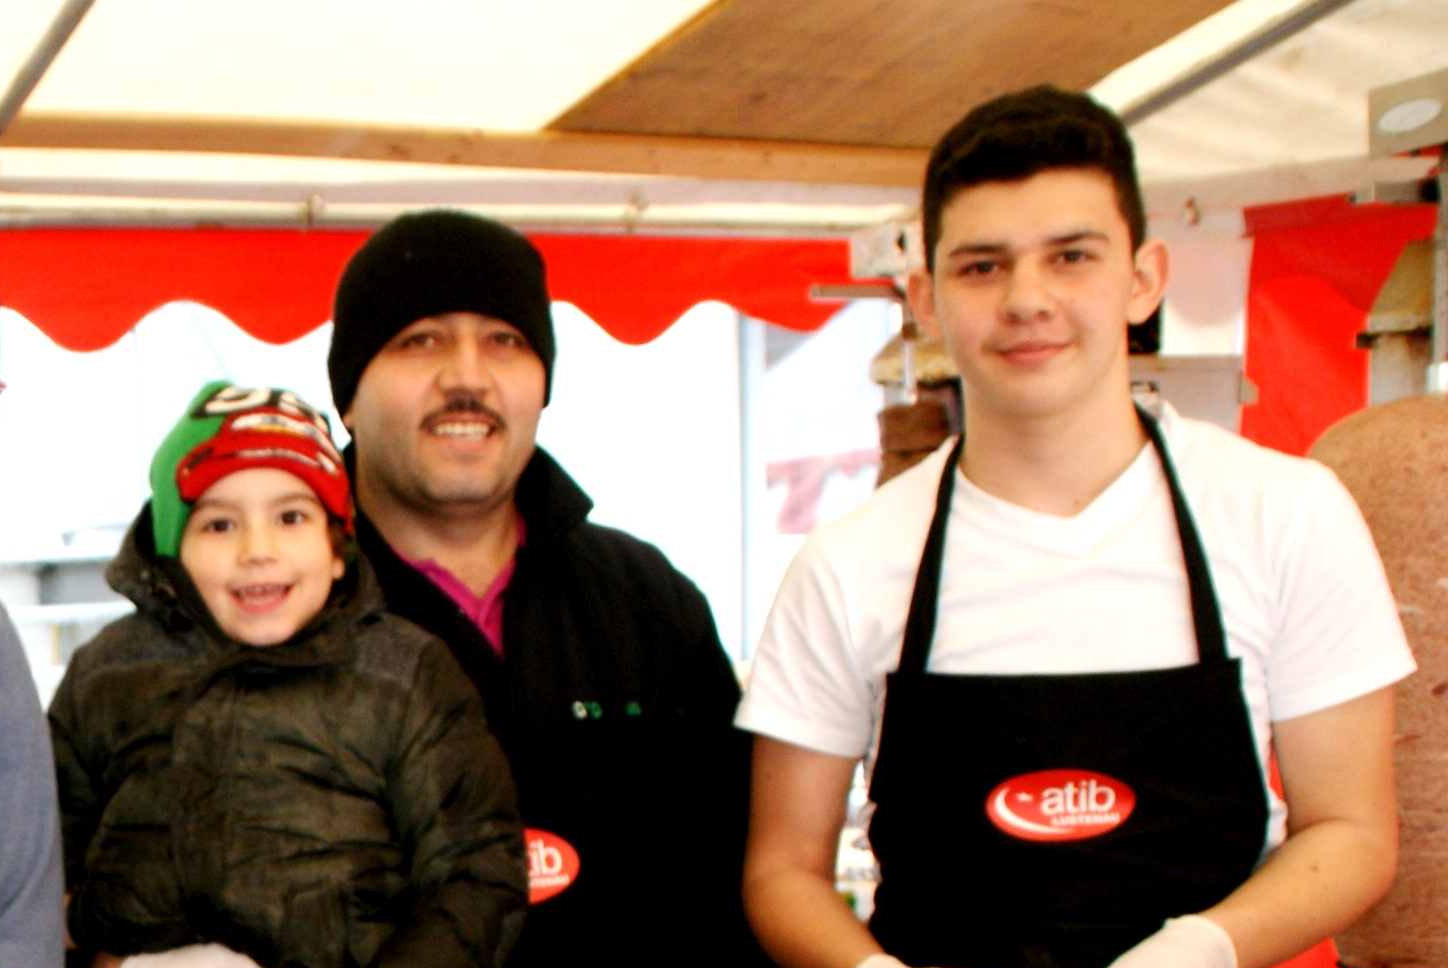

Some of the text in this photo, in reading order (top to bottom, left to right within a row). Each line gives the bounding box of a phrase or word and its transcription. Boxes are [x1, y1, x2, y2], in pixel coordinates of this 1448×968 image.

[1040, 779, 1116, 815] atib
[1051, 812, 1121, 827] LUSTENAU
[529, 838, 563, 876] ib
